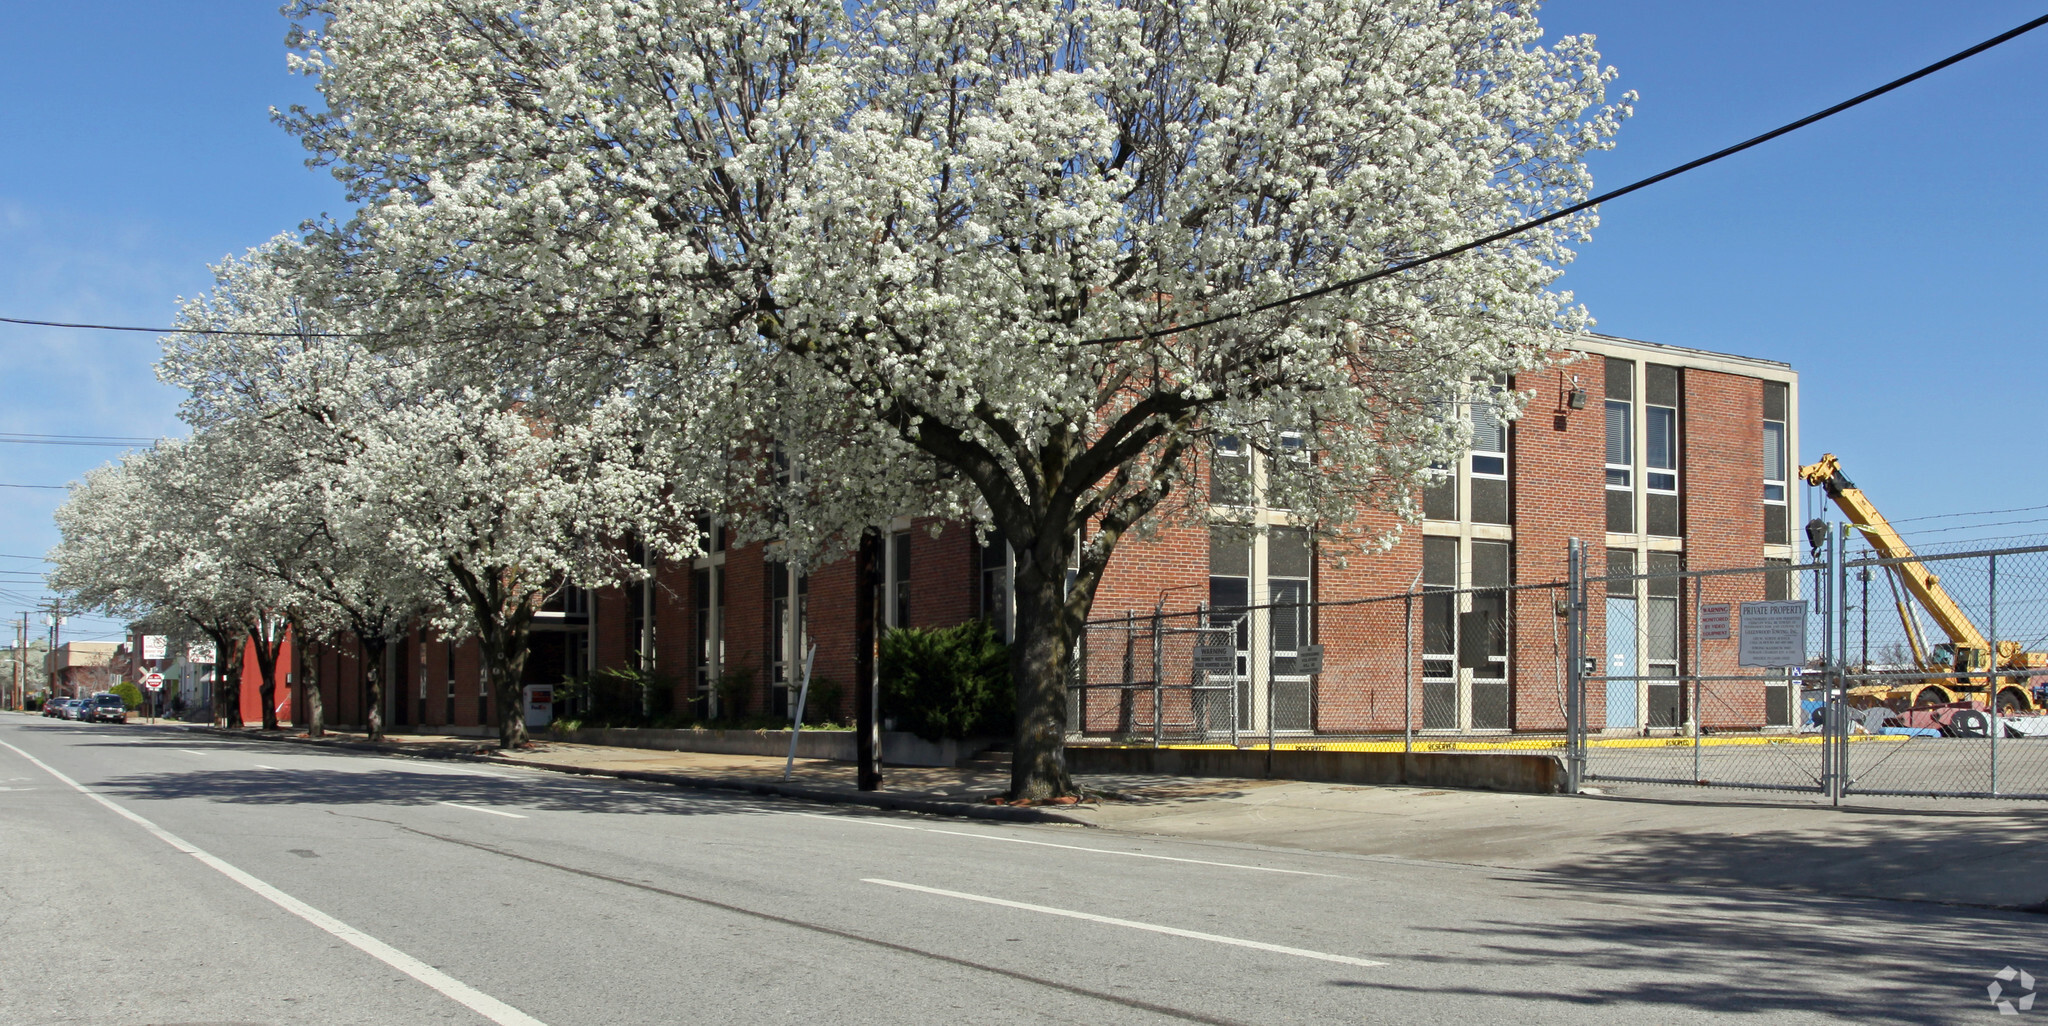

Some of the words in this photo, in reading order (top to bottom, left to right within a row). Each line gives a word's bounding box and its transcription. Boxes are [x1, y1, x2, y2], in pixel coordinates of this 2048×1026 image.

[1743, 606, 1768, 615] PRIVATE
[1770, 605, 1802, 614] PROPERTY
[1201, 647, 1227, 655] WARNING
